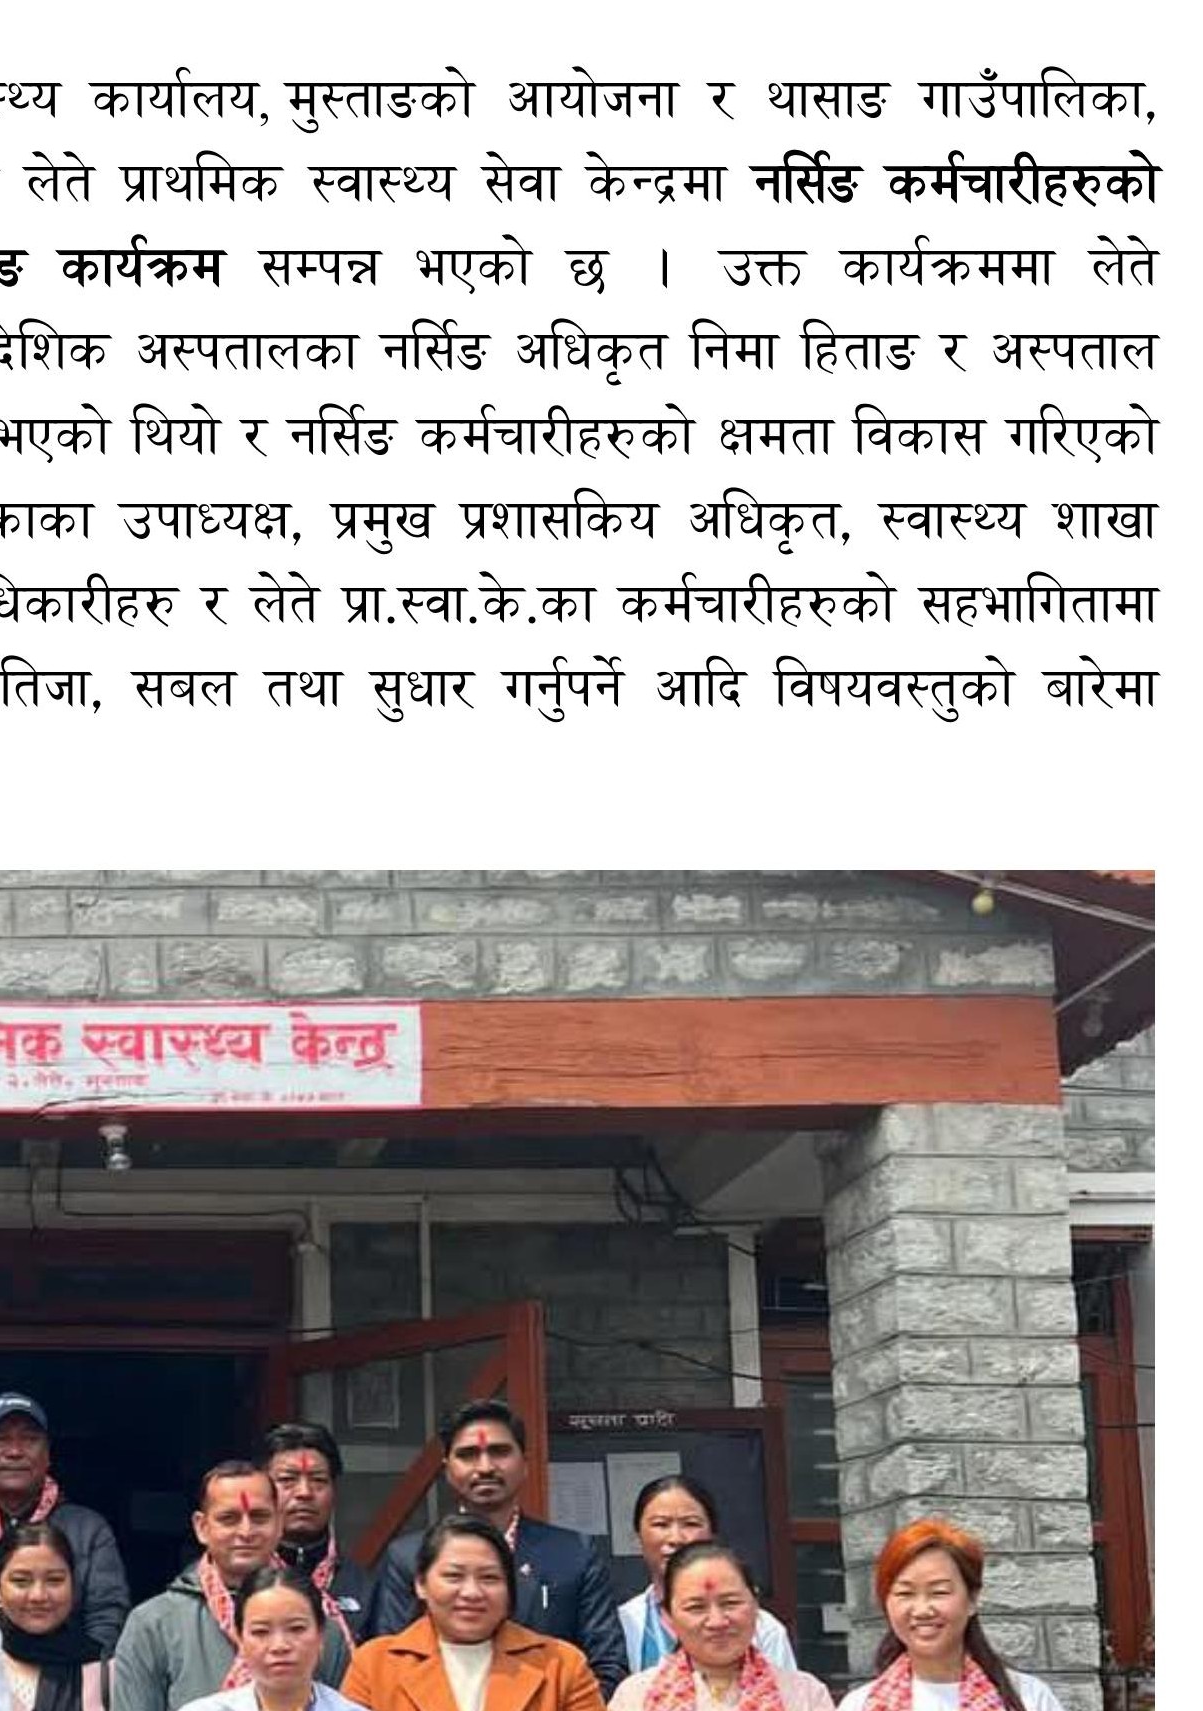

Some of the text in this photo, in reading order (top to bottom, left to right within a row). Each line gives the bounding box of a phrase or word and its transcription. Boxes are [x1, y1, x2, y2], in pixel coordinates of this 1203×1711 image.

[88, 66, 268, 124] कार्यालय,
[283, 66, 476, 133] मुस्ताङको
[509, 66, 680, 118] आयोजना
[706, 83, 736, 119] र
[769, 83, 891, 119] थासाङ
[917, 66, 1154, 124] गाउँपालिका,
[22, 151, 96, 201] लेते
[118, 150, 284, 202] प्राथमिक
[307, 167, 457, 203] स्वास्थ्य
[480, 151, 562, 203] सेवा
[584, 151, 728, 204] केन्द्रमा
[749, 150, 864, 204] नर्सिङ
[883, 150, 1163, 207] कर्मचारीहरुको
[56, 234, 228, 287] कार्यक्रम
[257, 251, 383, 287] सम्पन्न
[417, 234, 533, 294] भएको
[564, 251, 610, 294] छ
[717, 251, 808, 286] उक्त
[838, 235, 1056, 286] कार्यक्रममा
[1087, 235, 1160, 285] लेते
[138, 335, 360, 370] अस्पतालका
[378, 318, 491, 371] नर्सिङ
[517, 318, 669, 385] अधिकृत
[688, 318, 780, 370] निमा
[799, 319, 920, 374] हिताङ
[938, 335, 968, 371] र
[993, 335, 1160, 370] अस्पताल
[117, 504, 300, 545] उपाध्यक्ष,
[329, 504, 436, 554] प्रमुख
[458, 488, 660, 540] प्रशासकिय
[690, 487, 849, 554] अधिकृत,
[877, 504, 1027, 540] स्वास्थ्य
[1051, 504, 1159, 539] शाखा
[130, 672, 238, 708] सबल
[262, 672, 344, 707] तथा
[368, 672, 476, 722] सुधार
[500, 655, 626, 722] गर्नुपर्ने
[657, 656, 748, 707] आदि
[772, 655, 1016, 722] विषयवस्तुको
[1041, 655, 1160, 708] बारेमा
[81, 1022, 271, 1070] स्वास्थ्य
[290, 1011, 398, 1070] केन्द्र
